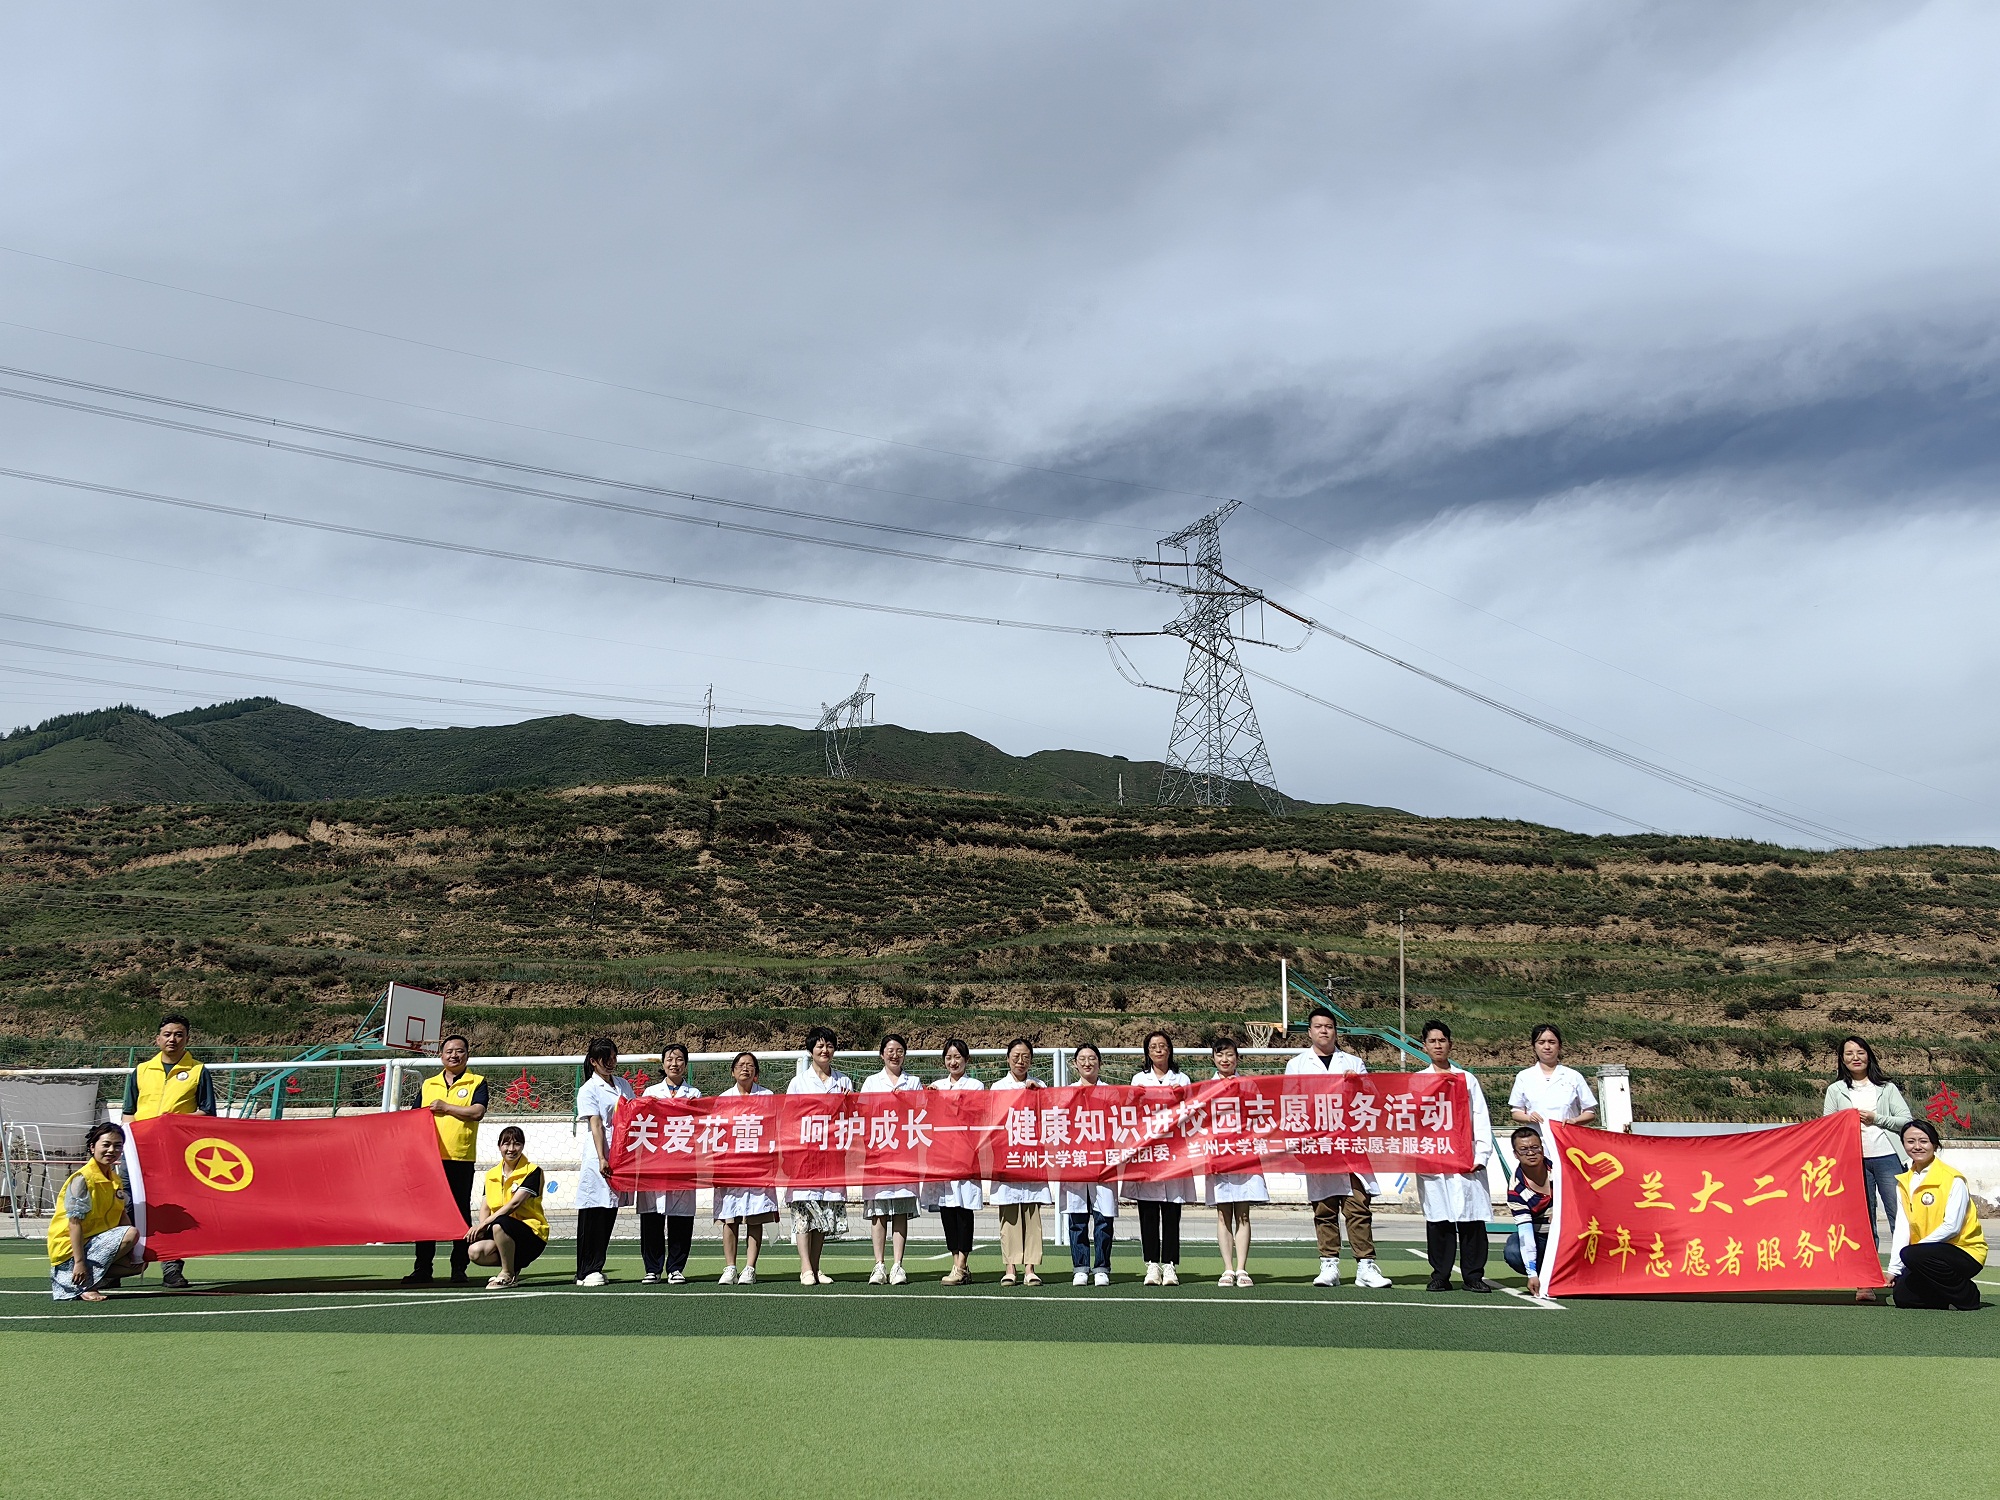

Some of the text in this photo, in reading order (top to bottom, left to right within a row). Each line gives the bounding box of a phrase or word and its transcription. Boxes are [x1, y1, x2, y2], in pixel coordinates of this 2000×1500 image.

[1925, 1081, 1971, 1129] 我
[1634, 1156, 1845, 1214] 兰大二院
[1577, 1215, 1861, 1278] 青年志愿者服务队
